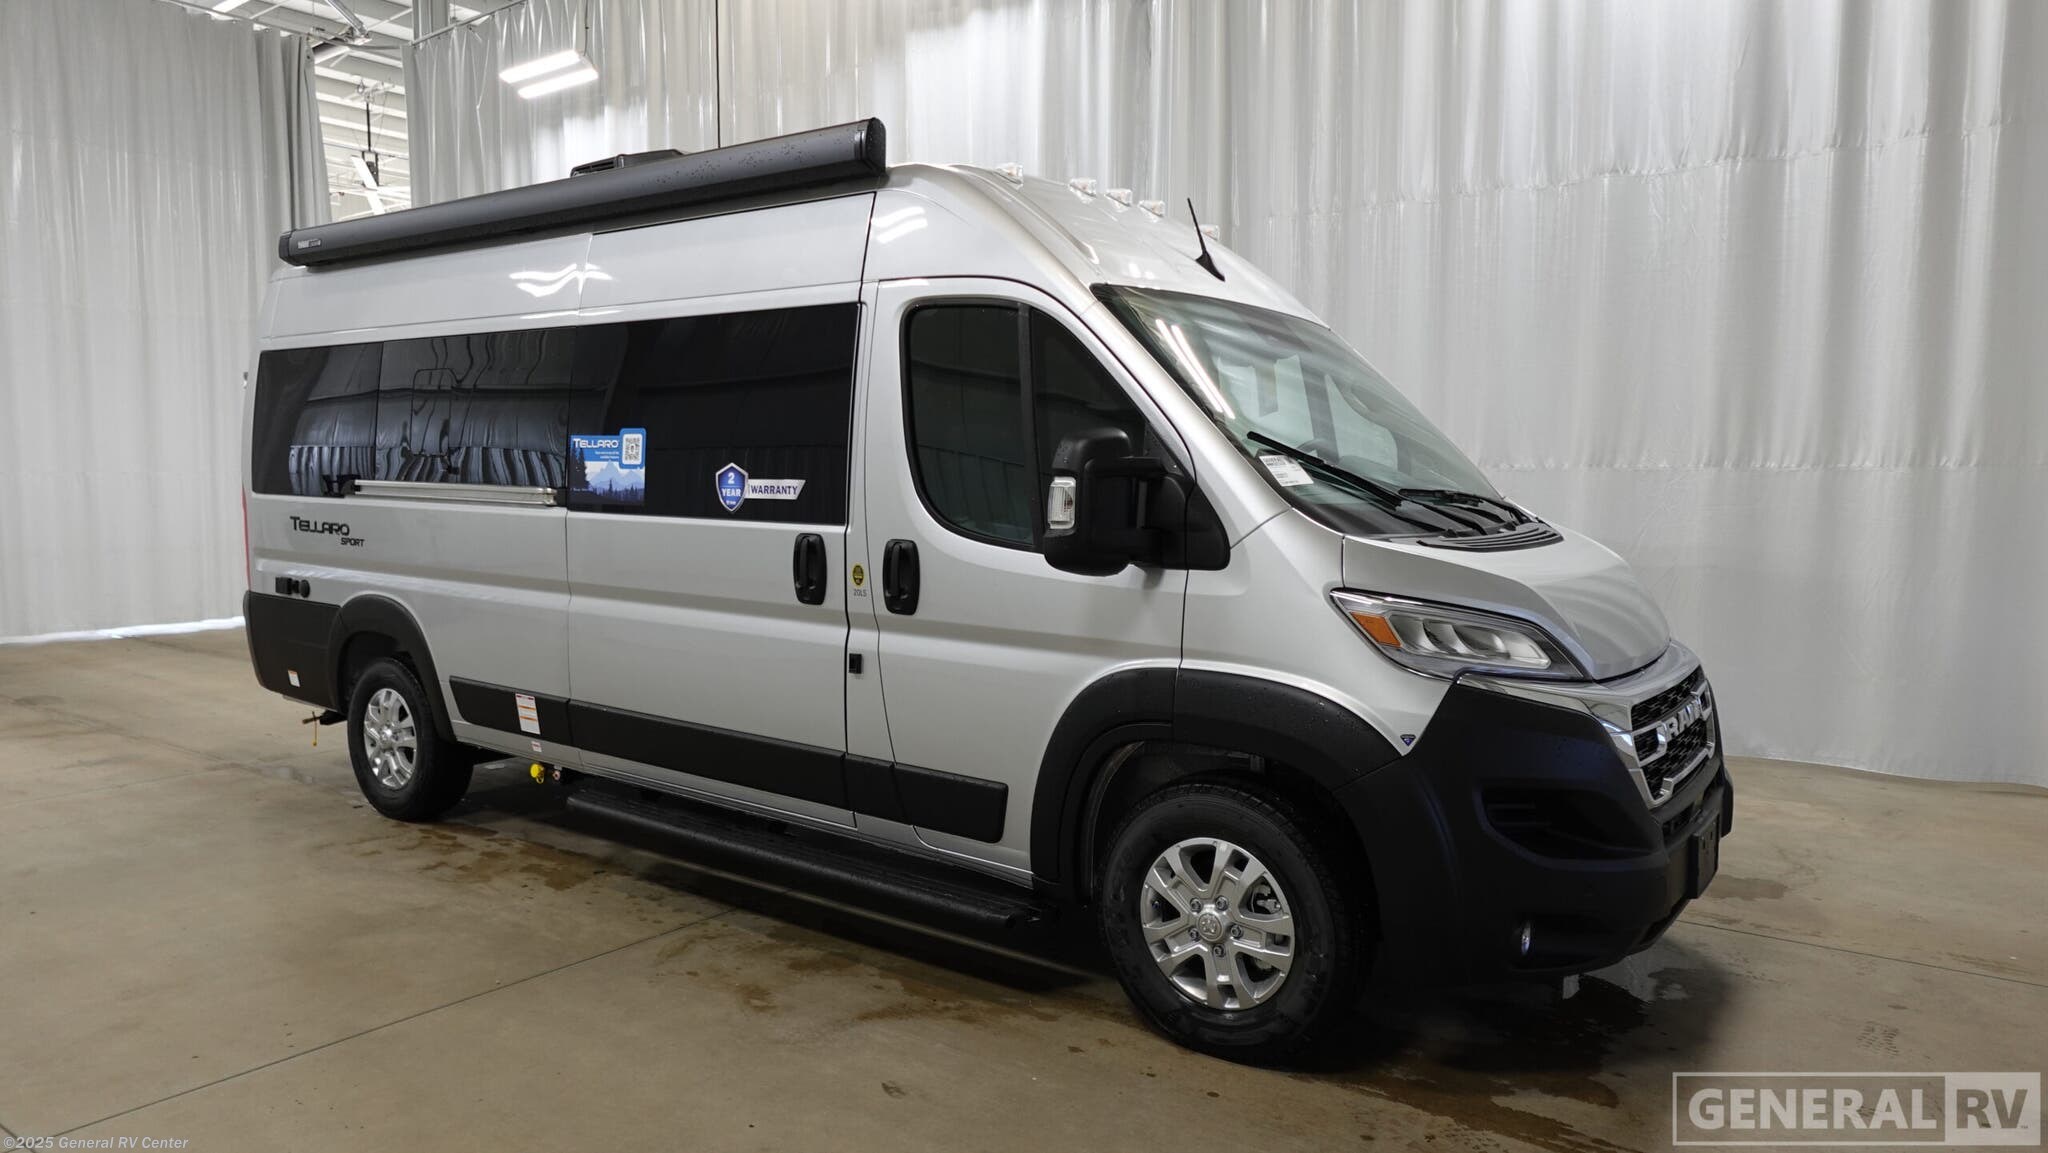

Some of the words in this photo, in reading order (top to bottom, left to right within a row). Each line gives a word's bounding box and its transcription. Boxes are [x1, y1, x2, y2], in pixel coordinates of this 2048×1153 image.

[573, 438, 619, 449] TELLARO
[727, 472, 736, 484] 2
[721, 487, 742, 497] YEAR
[750, 485, 798, 495] WARRANTY
[290, 516, 350, 536] TELLARO
[340, 537, 365, 547] SPORT
[1665, 699, 1701, 743] RAM
